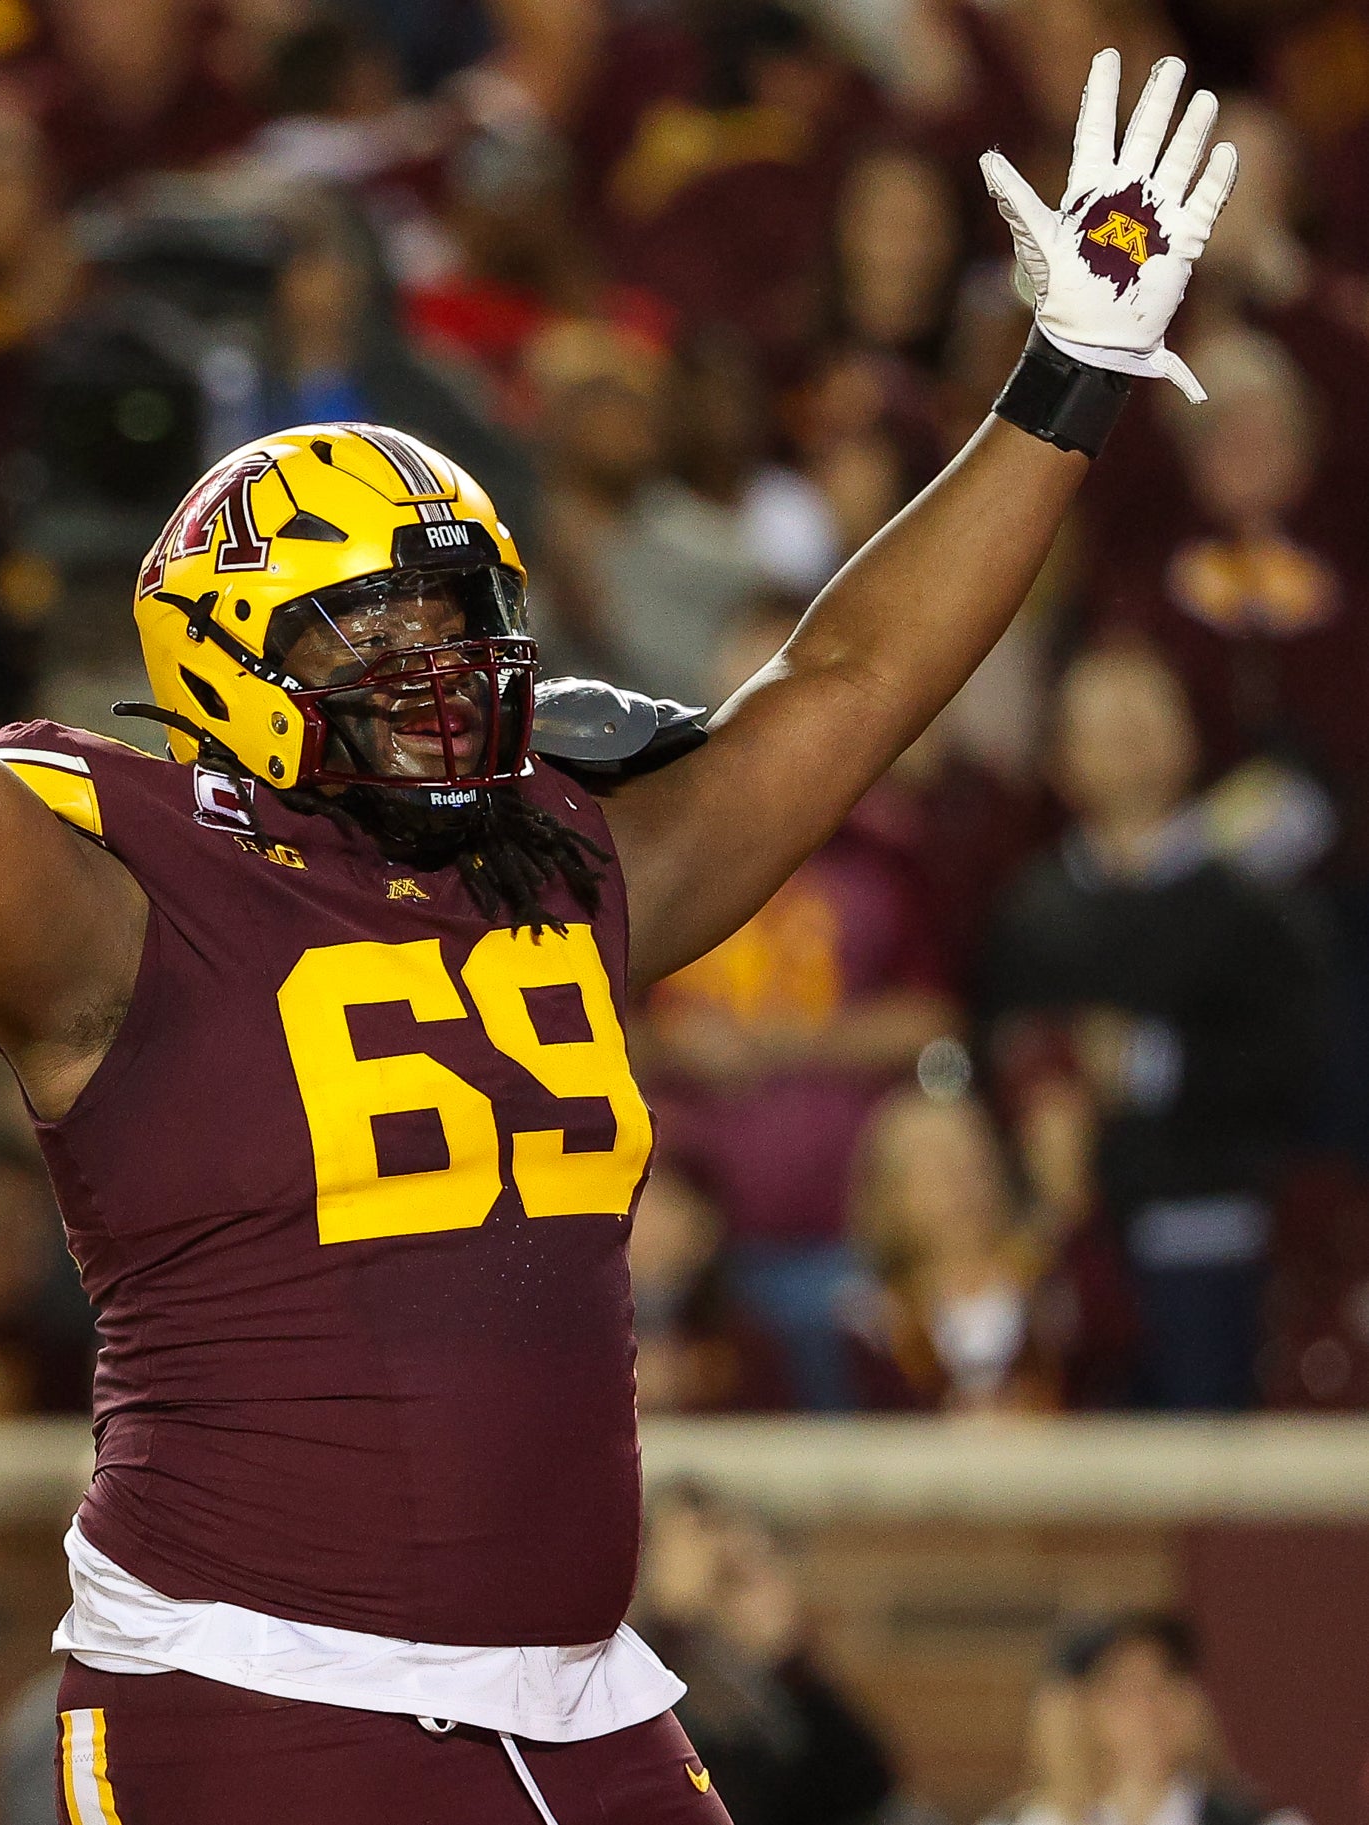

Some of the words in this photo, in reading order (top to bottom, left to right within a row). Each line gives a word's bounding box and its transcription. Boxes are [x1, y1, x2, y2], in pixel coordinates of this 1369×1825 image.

[1087, 210, 1149, 266] M
[139, 458, 278, 601] M
[425, 524, 470, 549] ROW
[430, 788, 477, 806] Riddell
[277, 922, 653, 1246] 69
